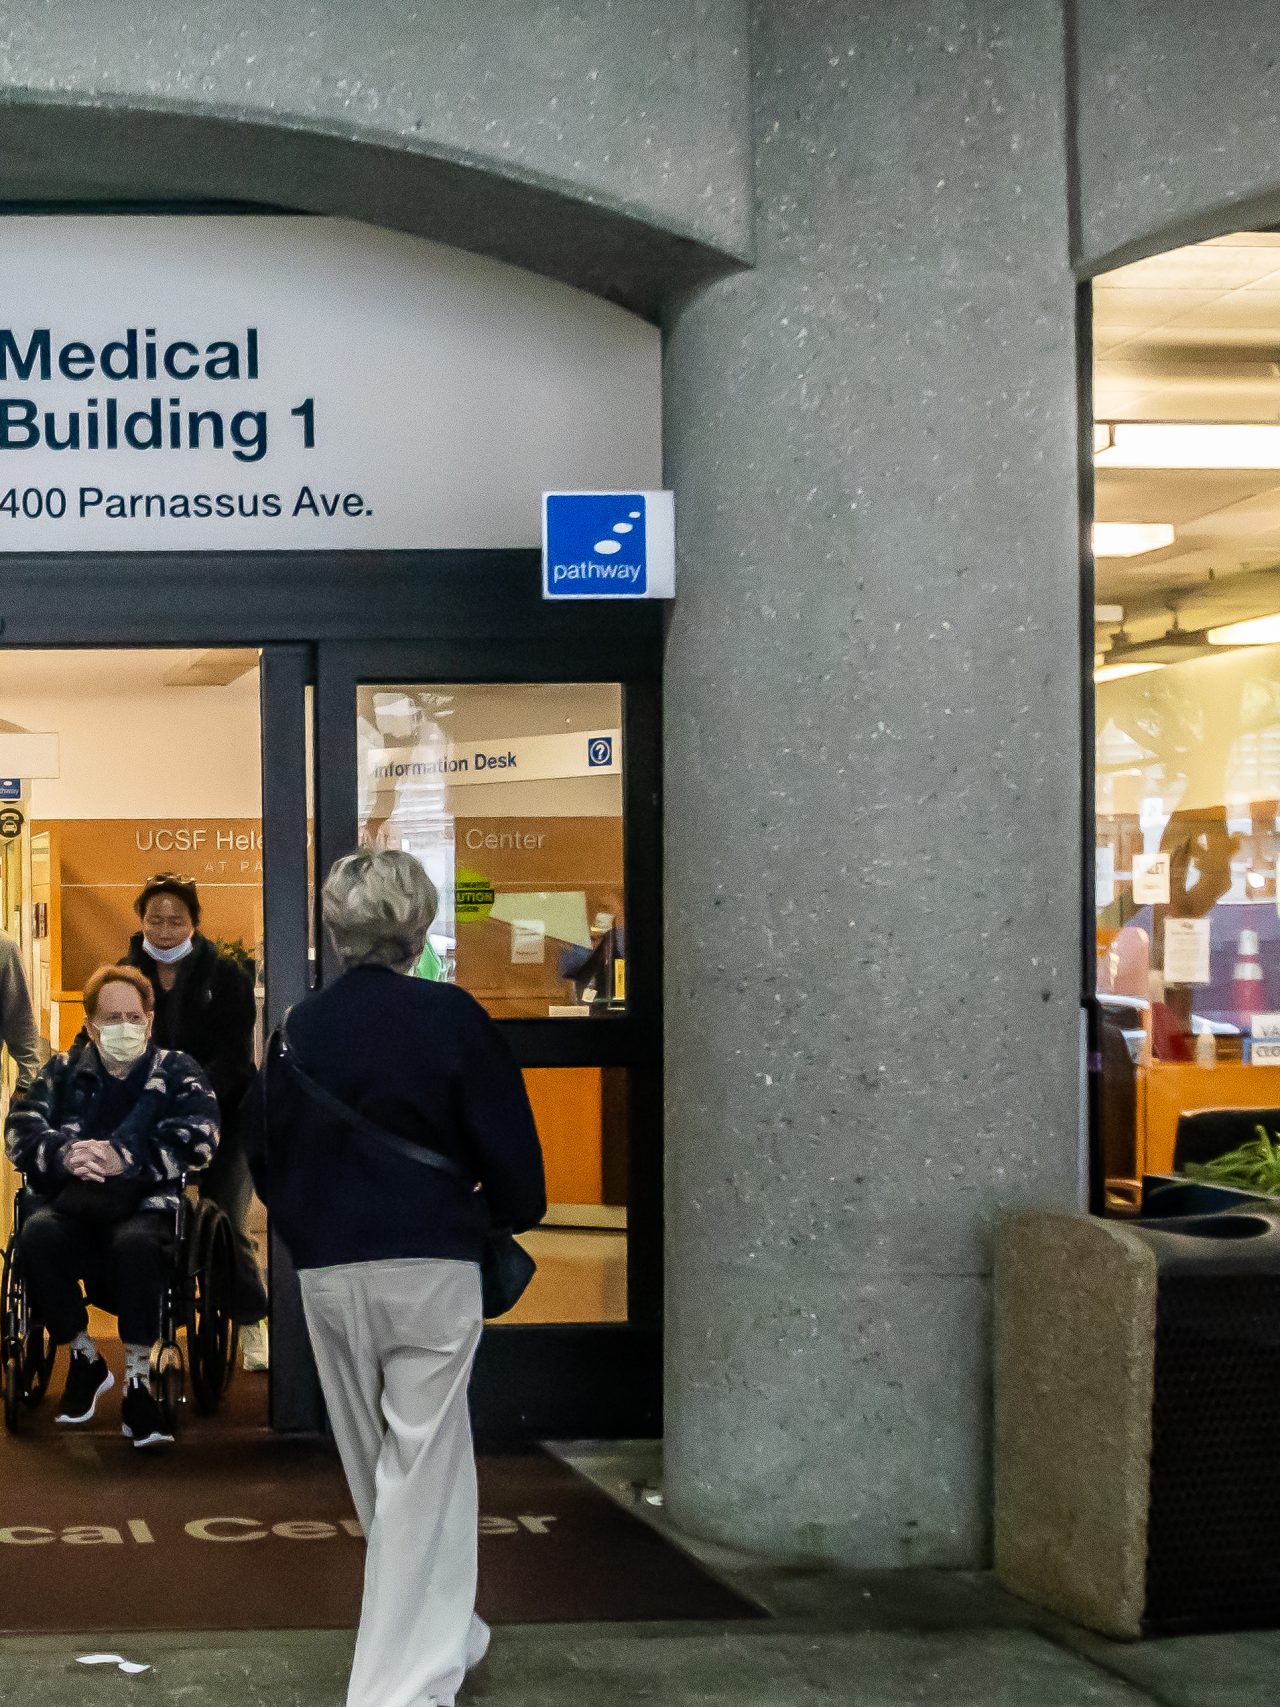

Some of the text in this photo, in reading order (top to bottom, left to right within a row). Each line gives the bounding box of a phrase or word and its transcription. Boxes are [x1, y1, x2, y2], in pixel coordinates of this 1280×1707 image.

[291, 398, 317, 450] 1
[79, 487, 283, 519] Parnassus
[293, 486, 374, 518] Ave.
[552, 559, 642, 585] pathway
[474, 751, 517, 770] Desk
[135, 828, 263, 851] UCSF Hel
[465, 828, 546, 849] Center
[204, 861, 227, 872] AT
[456, 892, 493, 902] UTION
[184, 1515, 557, 1542] Ceer
